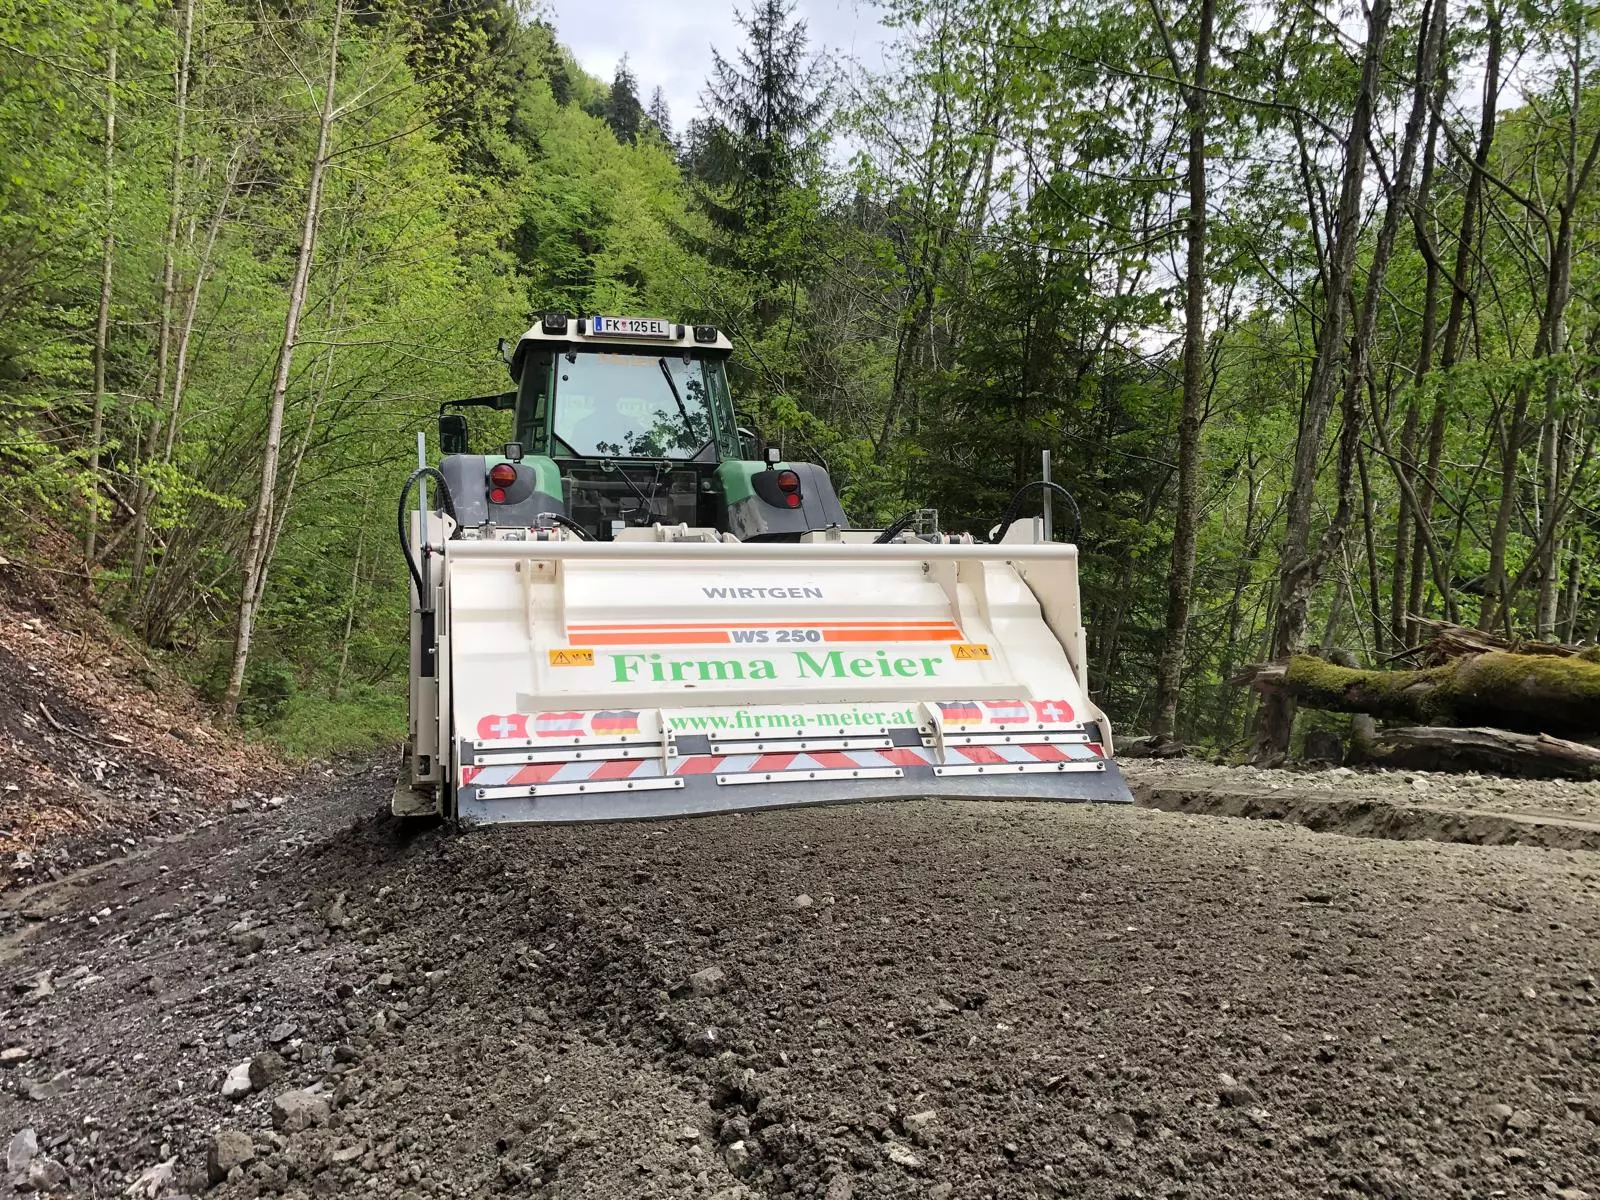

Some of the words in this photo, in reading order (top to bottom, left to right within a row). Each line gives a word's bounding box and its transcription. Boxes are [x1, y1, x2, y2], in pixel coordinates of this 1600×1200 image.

[605, 319, 620, 331] FK
[628, 320, 648, 332] 125
[650, 321, 664, 333] EL
[702, 587, 823, 599] WIRTGEN
[731, 630, 770, 644] WS
[776, 629, 821, 643] 250
[608, 652, 779, 683] Firma
[791, 649, 944, 679] Meier
[668, 707, 917, 731] www.firma-meier.at
